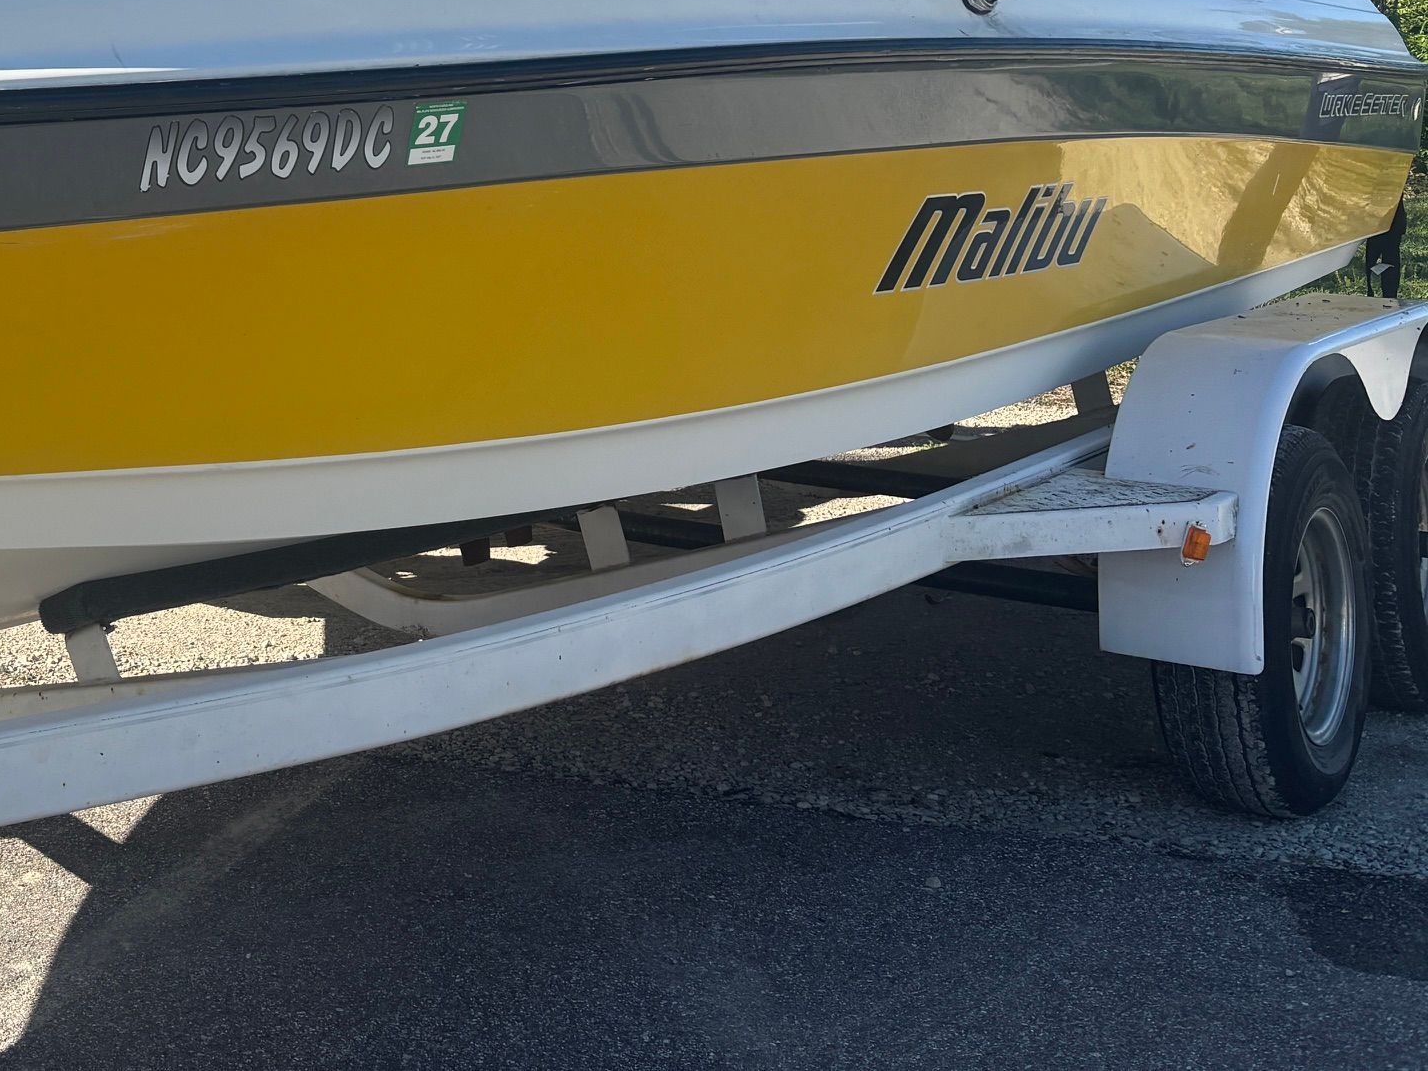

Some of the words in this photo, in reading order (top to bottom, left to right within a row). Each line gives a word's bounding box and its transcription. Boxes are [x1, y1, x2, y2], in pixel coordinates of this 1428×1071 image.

[140, 105, 395, 193] NC9569DC
[414, 113, 459, 145] 27
[872, 181, 1109, 295] Malibu
